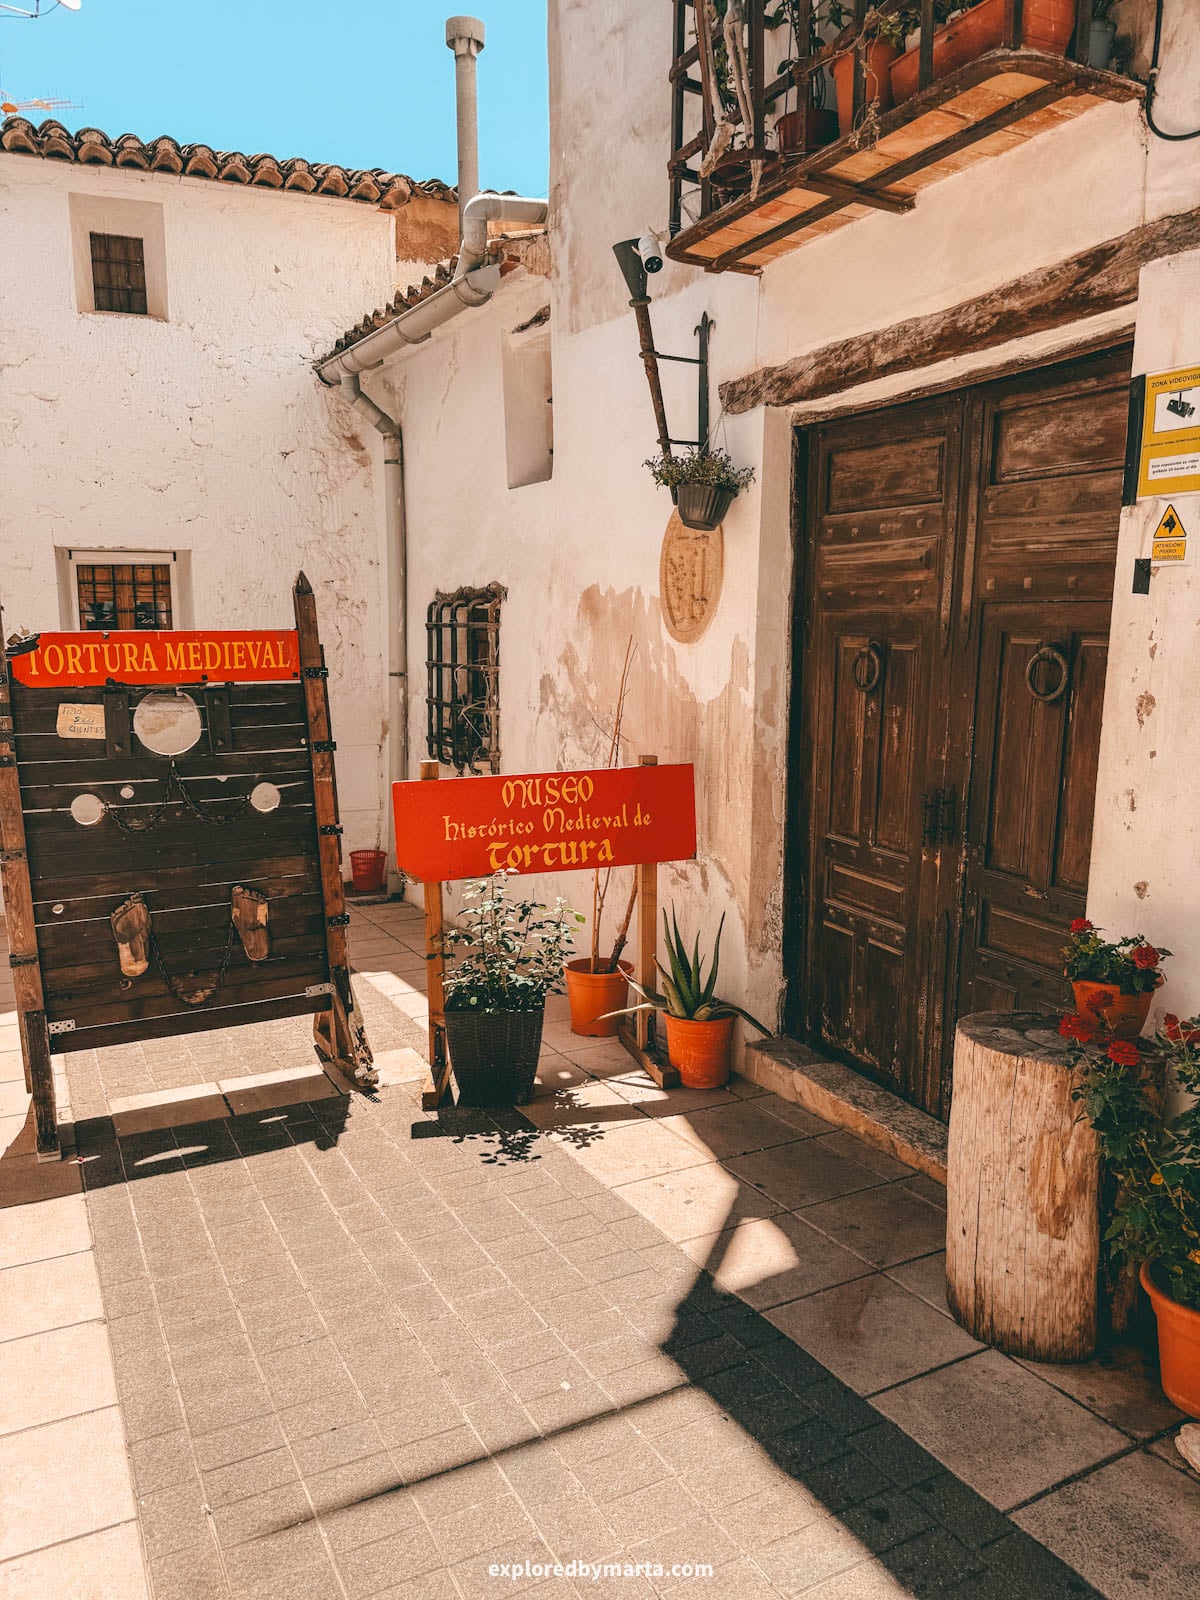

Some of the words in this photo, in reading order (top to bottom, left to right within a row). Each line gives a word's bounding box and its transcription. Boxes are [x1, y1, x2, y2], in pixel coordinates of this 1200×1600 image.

[1151, 380, 1168, 388] ZONA
[29, 642, 158, 675] TORTURA
[165, 640, 291, 670] MEDIEVAL
[501, 775, 594, 808] MUSEO
[542, 803, 629, 834] Medieval
[632, 803, 652, 827] de
